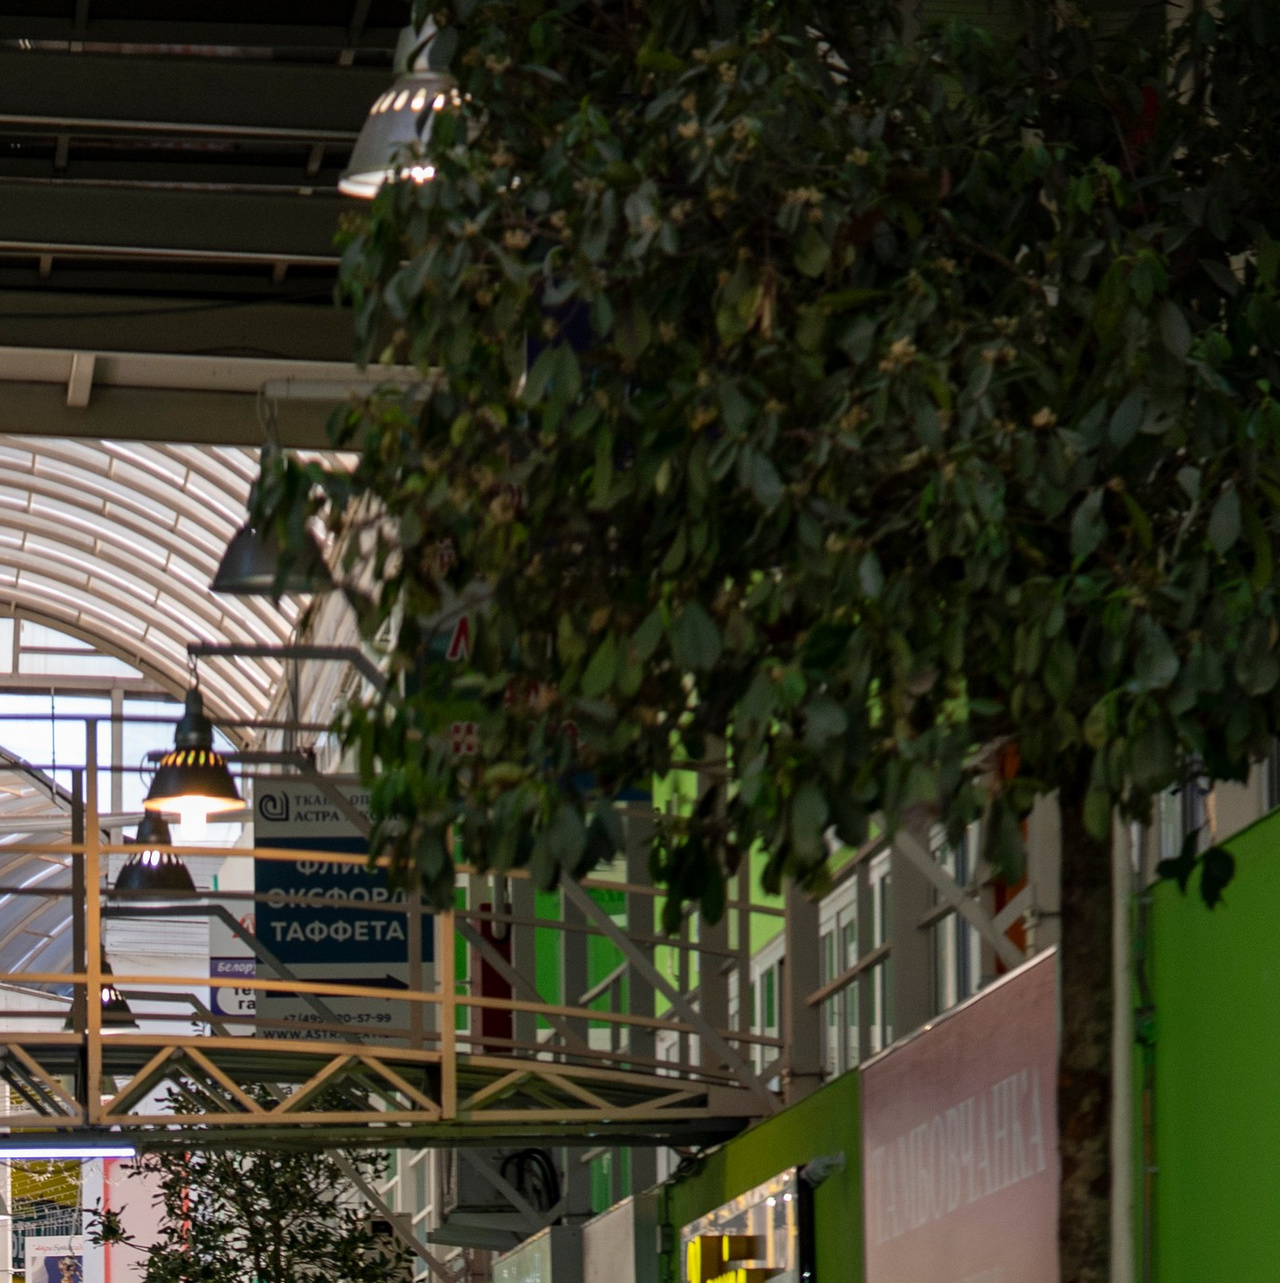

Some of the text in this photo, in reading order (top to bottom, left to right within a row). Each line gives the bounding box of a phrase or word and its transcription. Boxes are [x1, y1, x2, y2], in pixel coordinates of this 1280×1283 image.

[295, 810, 340, 823] АСТРА
[271, 921, 405, 942] ТАФФЕТА
[332, 1013, 392, 1024] 20-57-99
